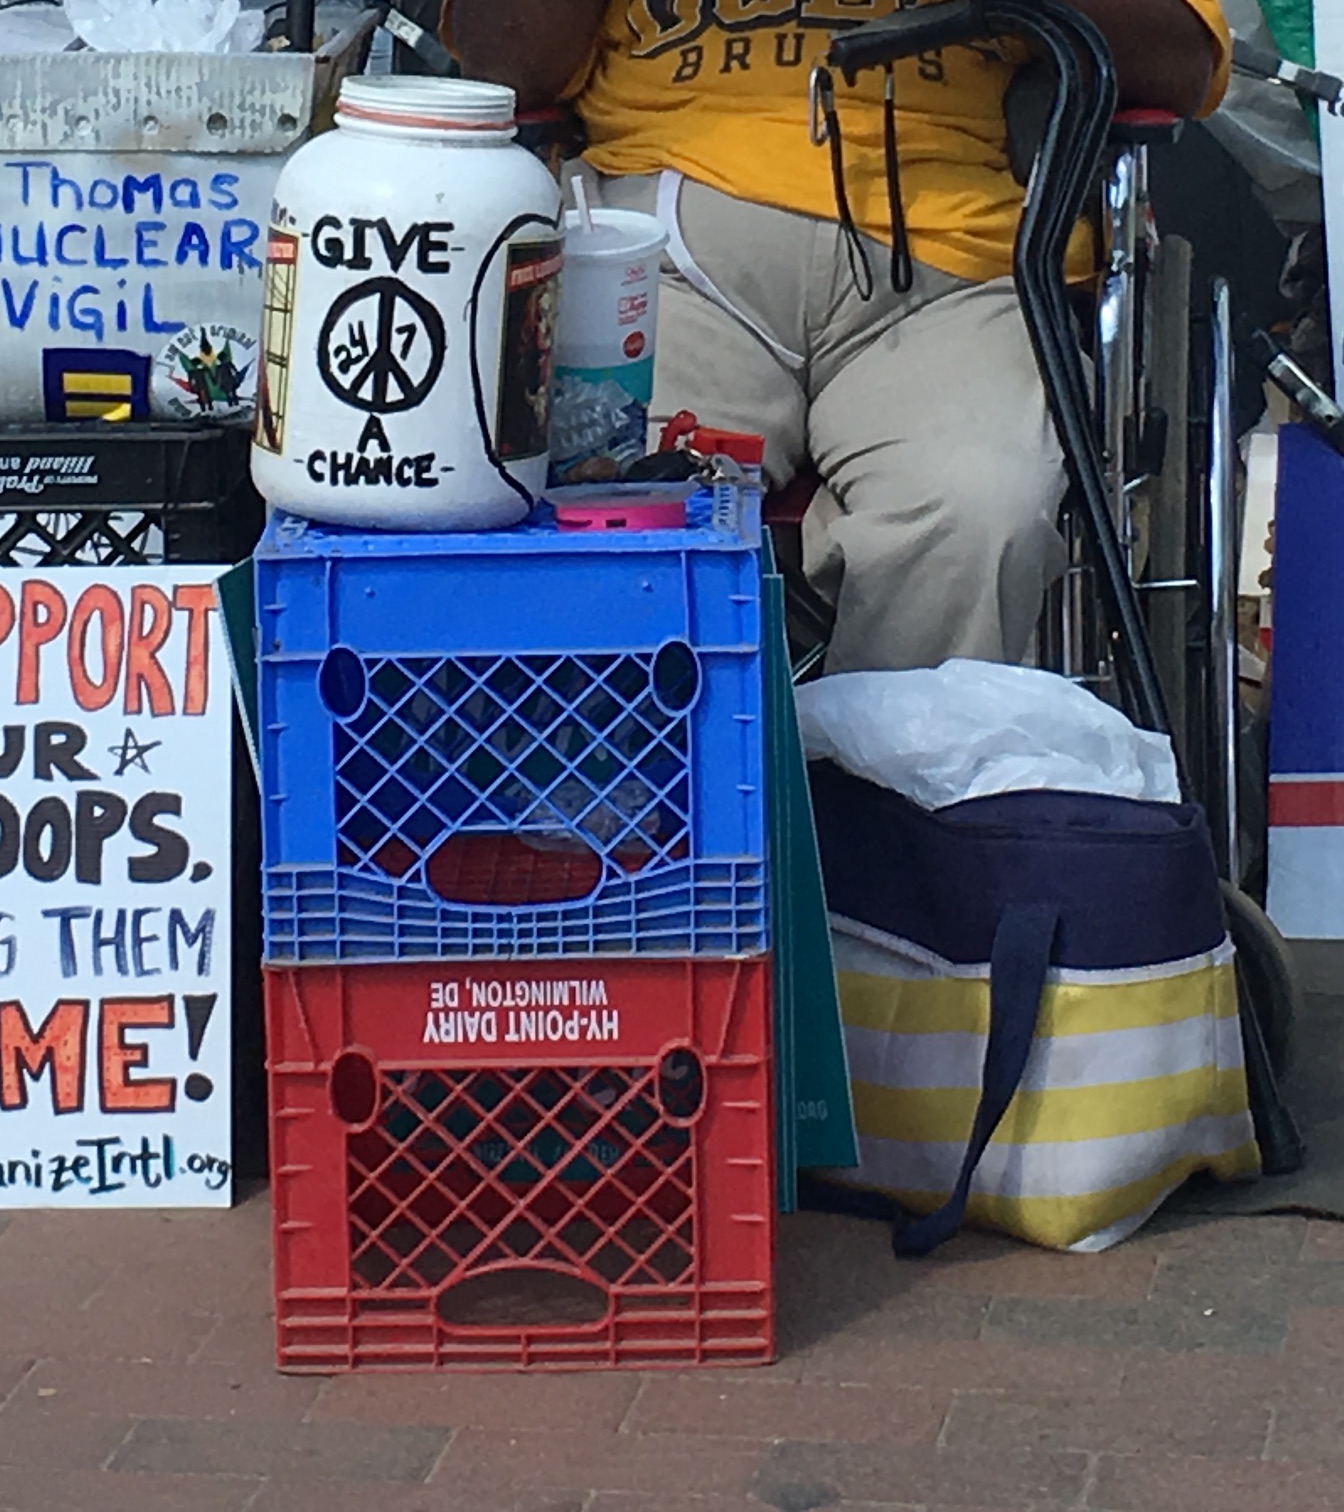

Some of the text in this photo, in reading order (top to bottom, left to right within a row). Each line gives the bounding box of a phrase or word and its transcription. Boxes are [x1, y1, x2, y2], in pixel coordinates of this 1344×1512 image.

[671, 31, 949, 85] BRUS
[310, 215, 455, 275] GIVE
[356, 412, 392, 454] A
[23, 455, 96, 474] Hiland
[306, 449, 440, 487] CHANCE
[42, 905, 216, 979] THEM
[430, 976, 608, 1009] WILMINGTON, DE
[423, 1009, 619, 1044] HY-POINT DAIRY
